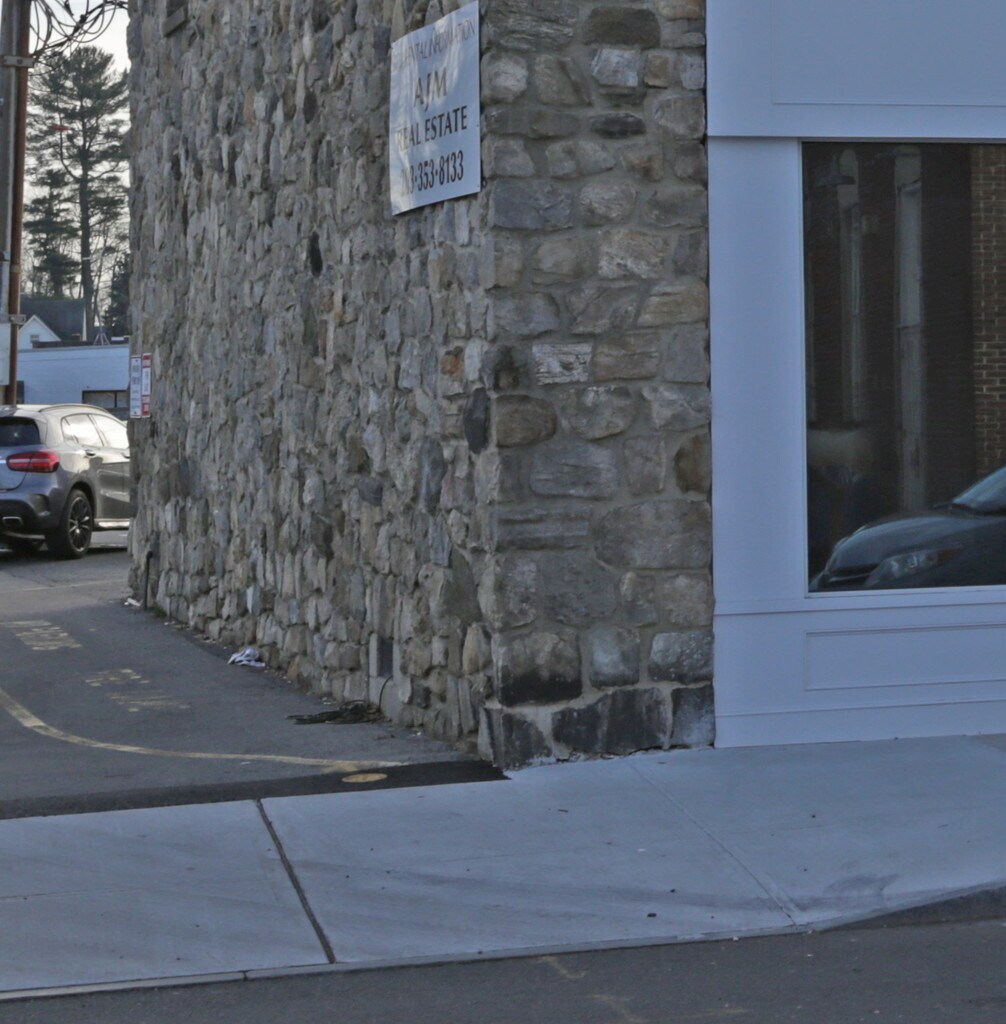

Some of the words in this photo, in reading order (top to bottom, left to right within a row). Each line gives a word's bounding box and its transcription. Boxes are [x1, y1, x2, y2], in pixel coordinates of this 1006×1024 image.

[413, 66, 447, 112] AJM
[396, 122, 422, 151] REAL
[424, 105, 467, 143] ESTATE
